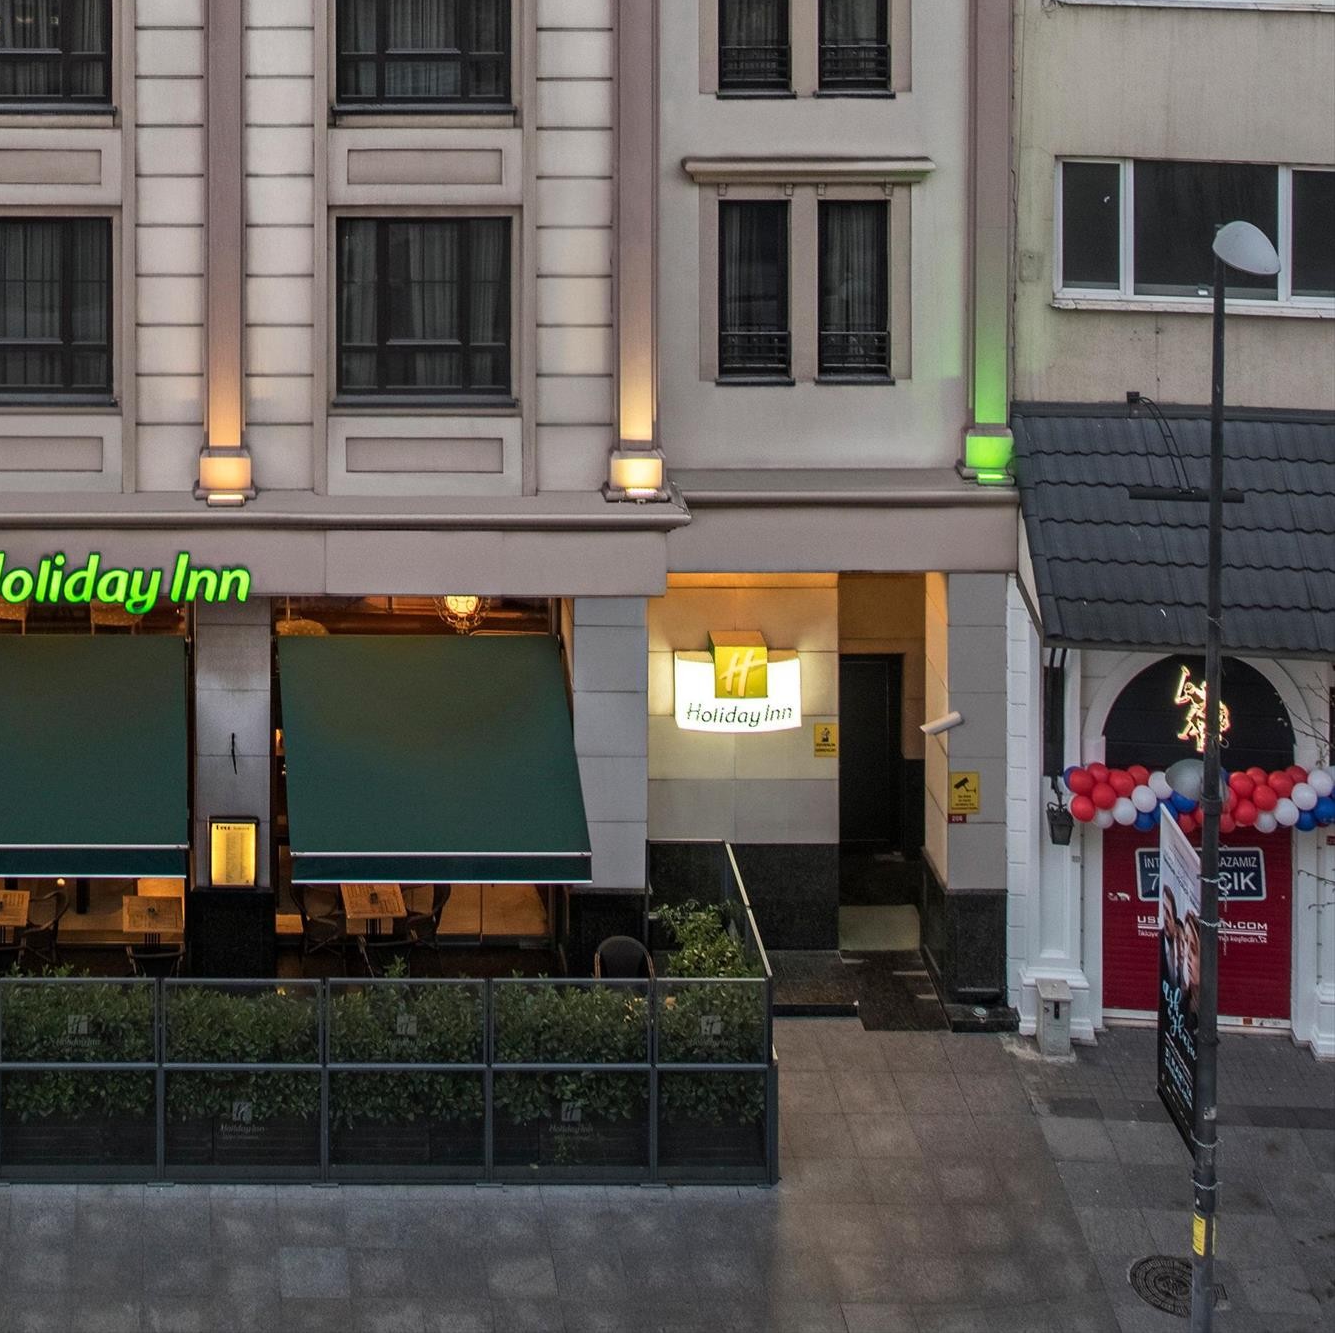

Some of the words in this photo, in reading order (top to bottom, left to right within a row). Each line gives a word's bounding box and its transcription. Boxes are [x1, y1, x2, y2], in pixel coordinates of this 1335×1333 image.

[170, 550, 252, 603] Inn
[686, 702, 761, 728] Holiday
[764, 704, 793, 722] Inn
[1218, 856, 1258, 869] AZAMIZ
[1218, 872, 1258, 895] ÇIK
